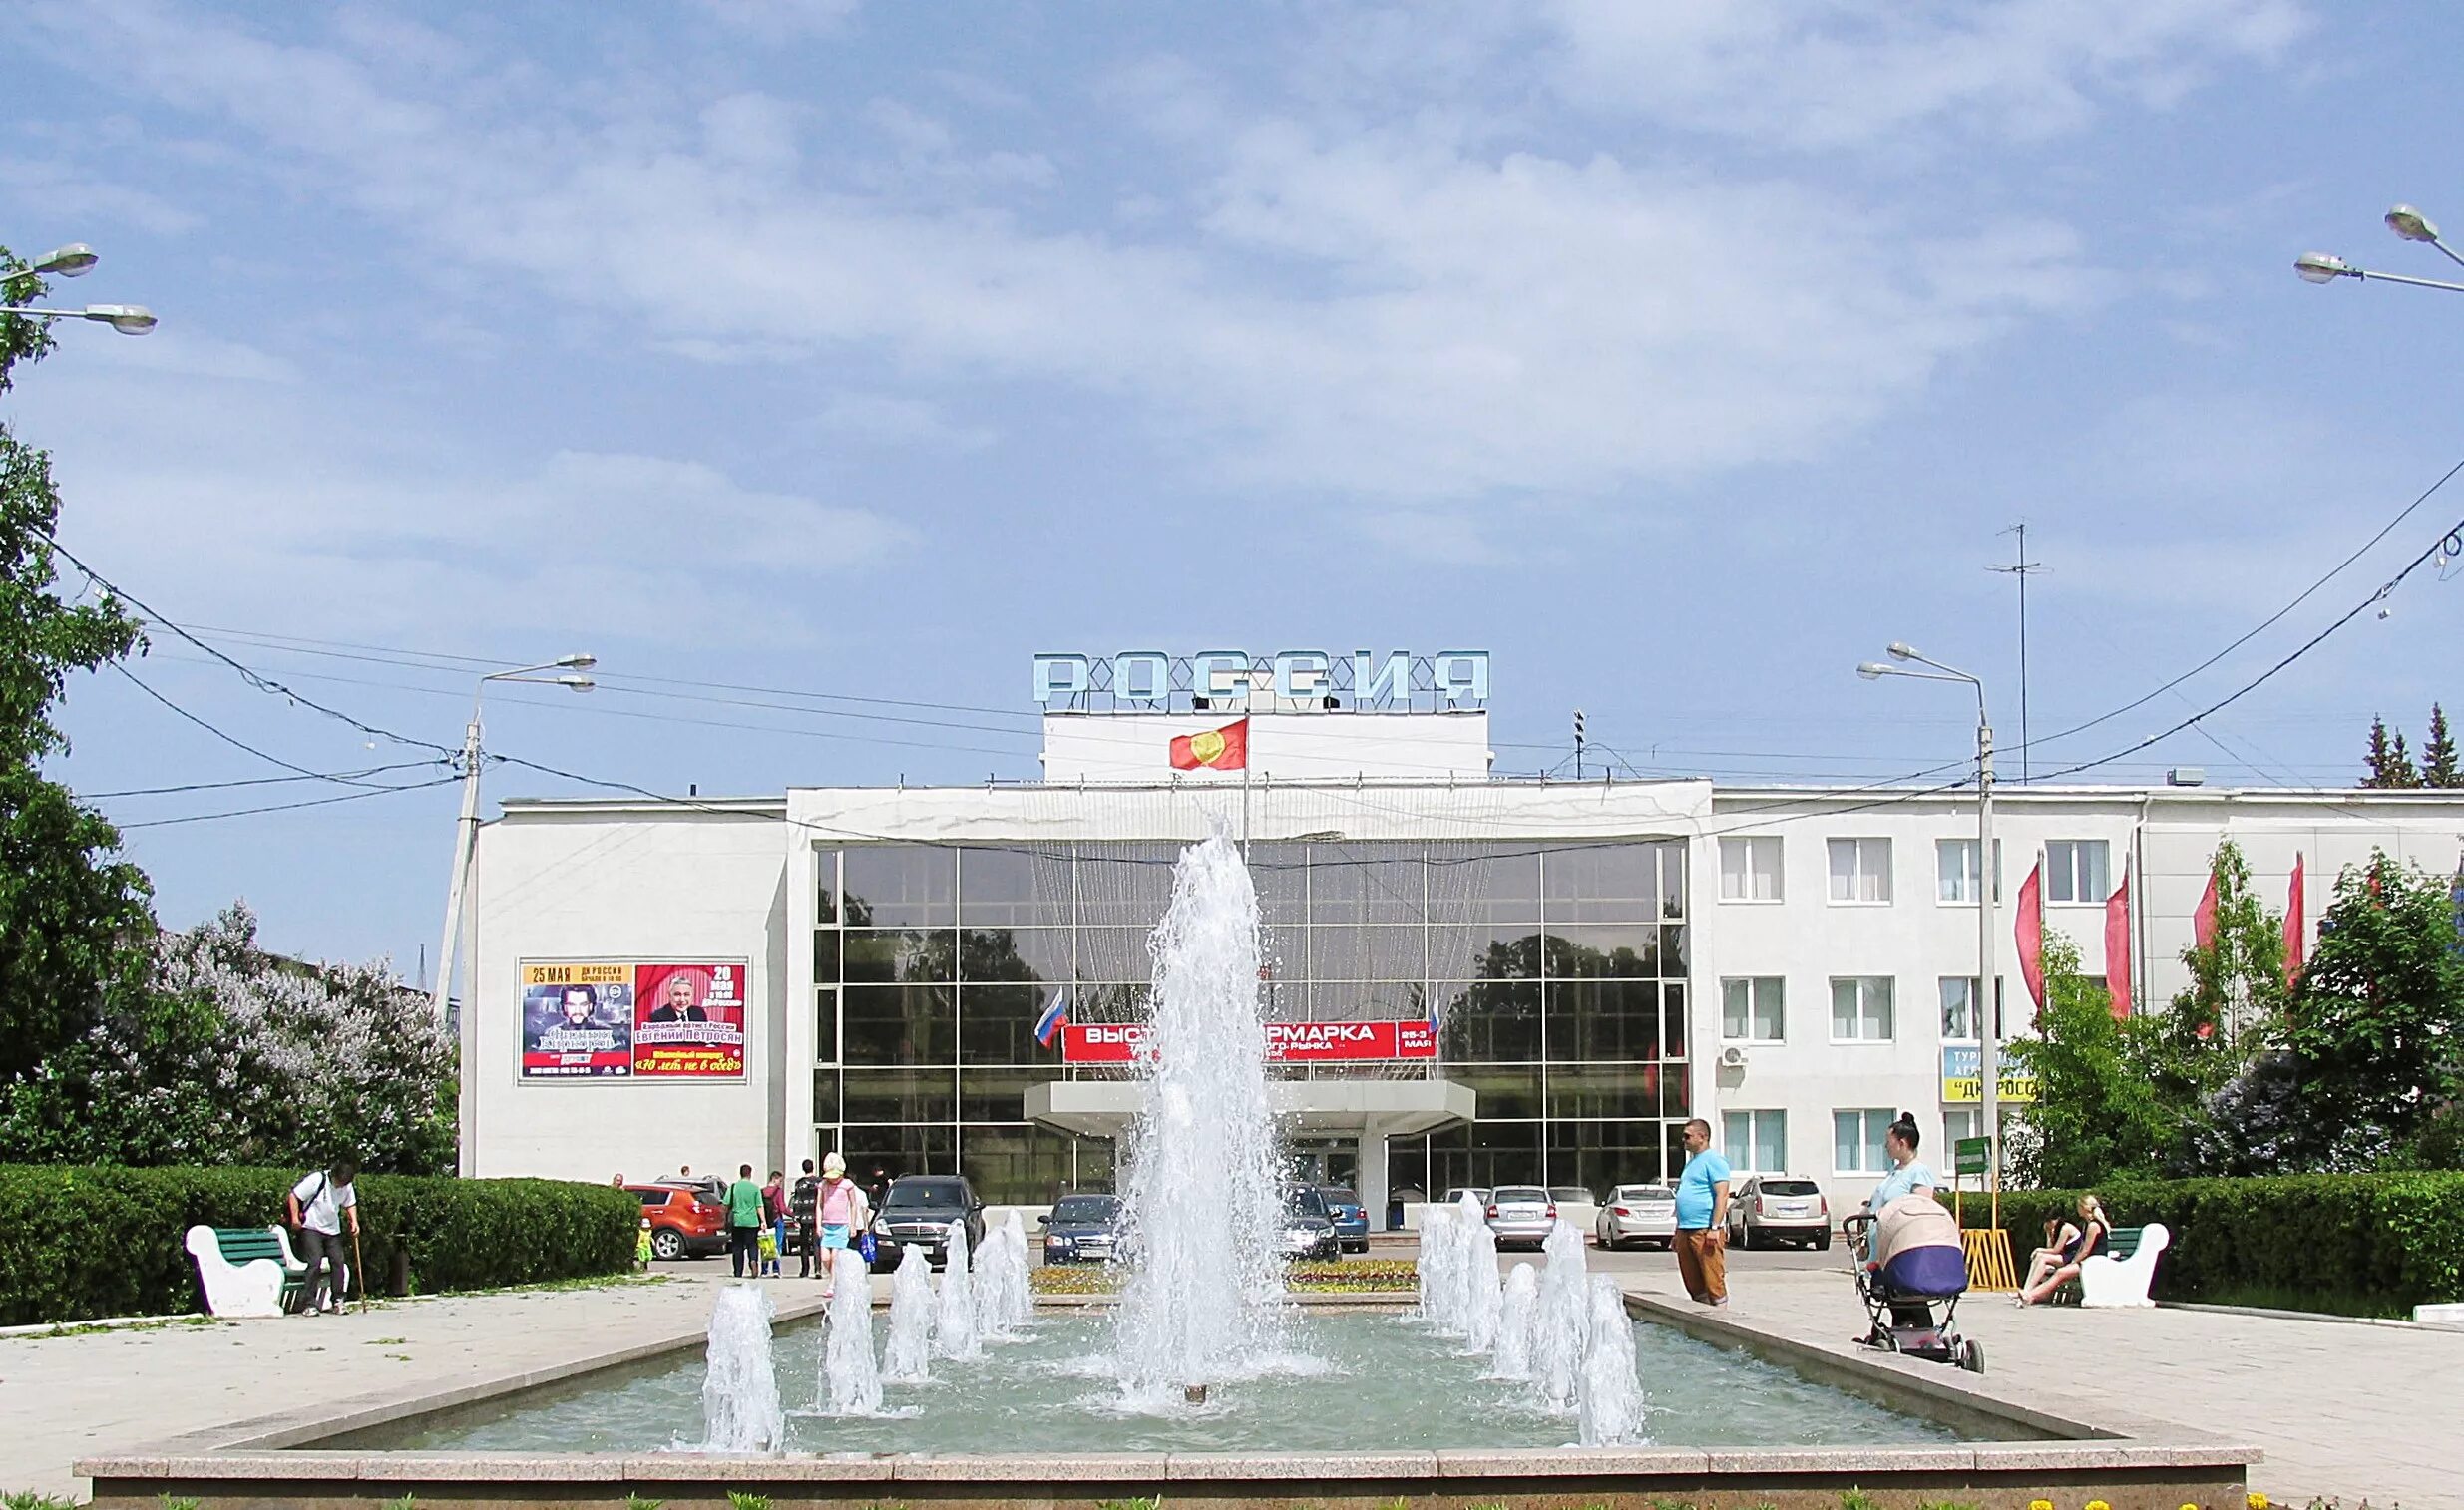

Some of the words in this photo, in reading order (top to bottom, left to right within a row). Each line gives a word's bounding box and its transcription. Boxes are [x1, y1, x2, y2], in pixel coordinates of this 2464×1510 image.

[1033, 650, 1490, 701] РОССИЯ
[533, 967, 545, 982] 25
[548, 967, 571, 982] МАЯ
[714, 966, 730, 980] 20
[1266, 1025, 1376, 1041] РМАРКА
[1996, 1080, 2037, 1096] РОСС
